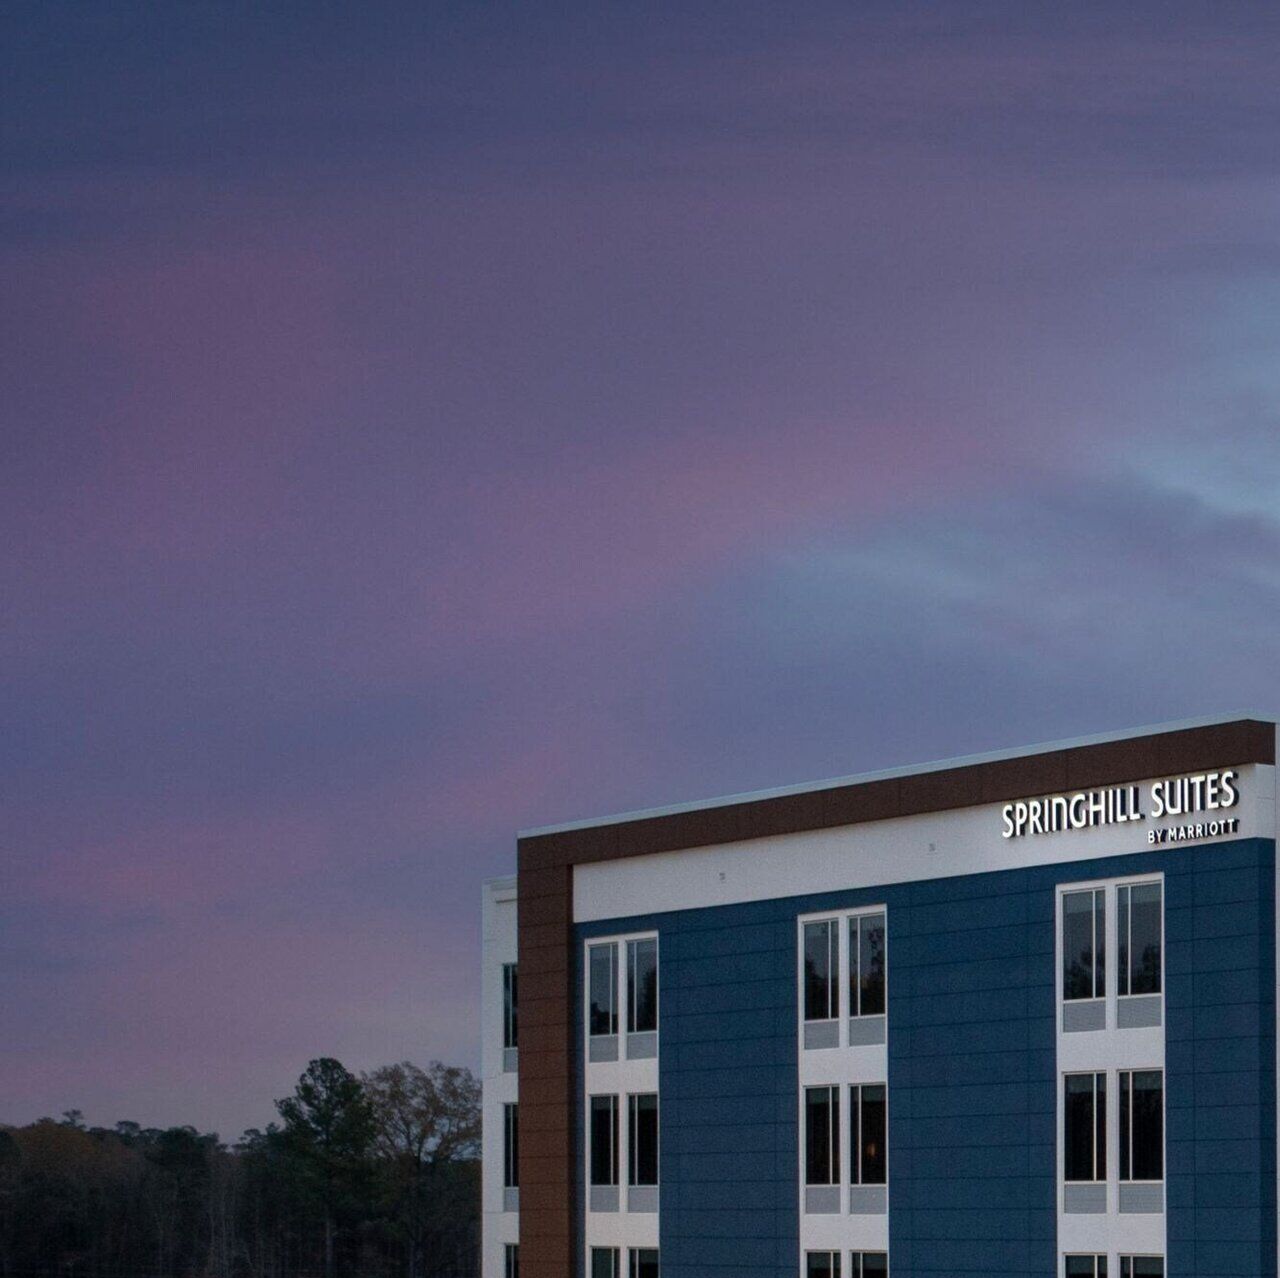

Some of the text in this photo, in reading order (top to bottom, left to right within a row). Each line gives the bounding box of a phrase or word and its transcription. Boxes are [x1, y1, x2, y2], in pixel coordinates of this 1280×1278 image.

[1002, 771, 1236, 838] SPRINGHILL SUITES
[1148, 818, 1236, 844] BY MARRIOTT
